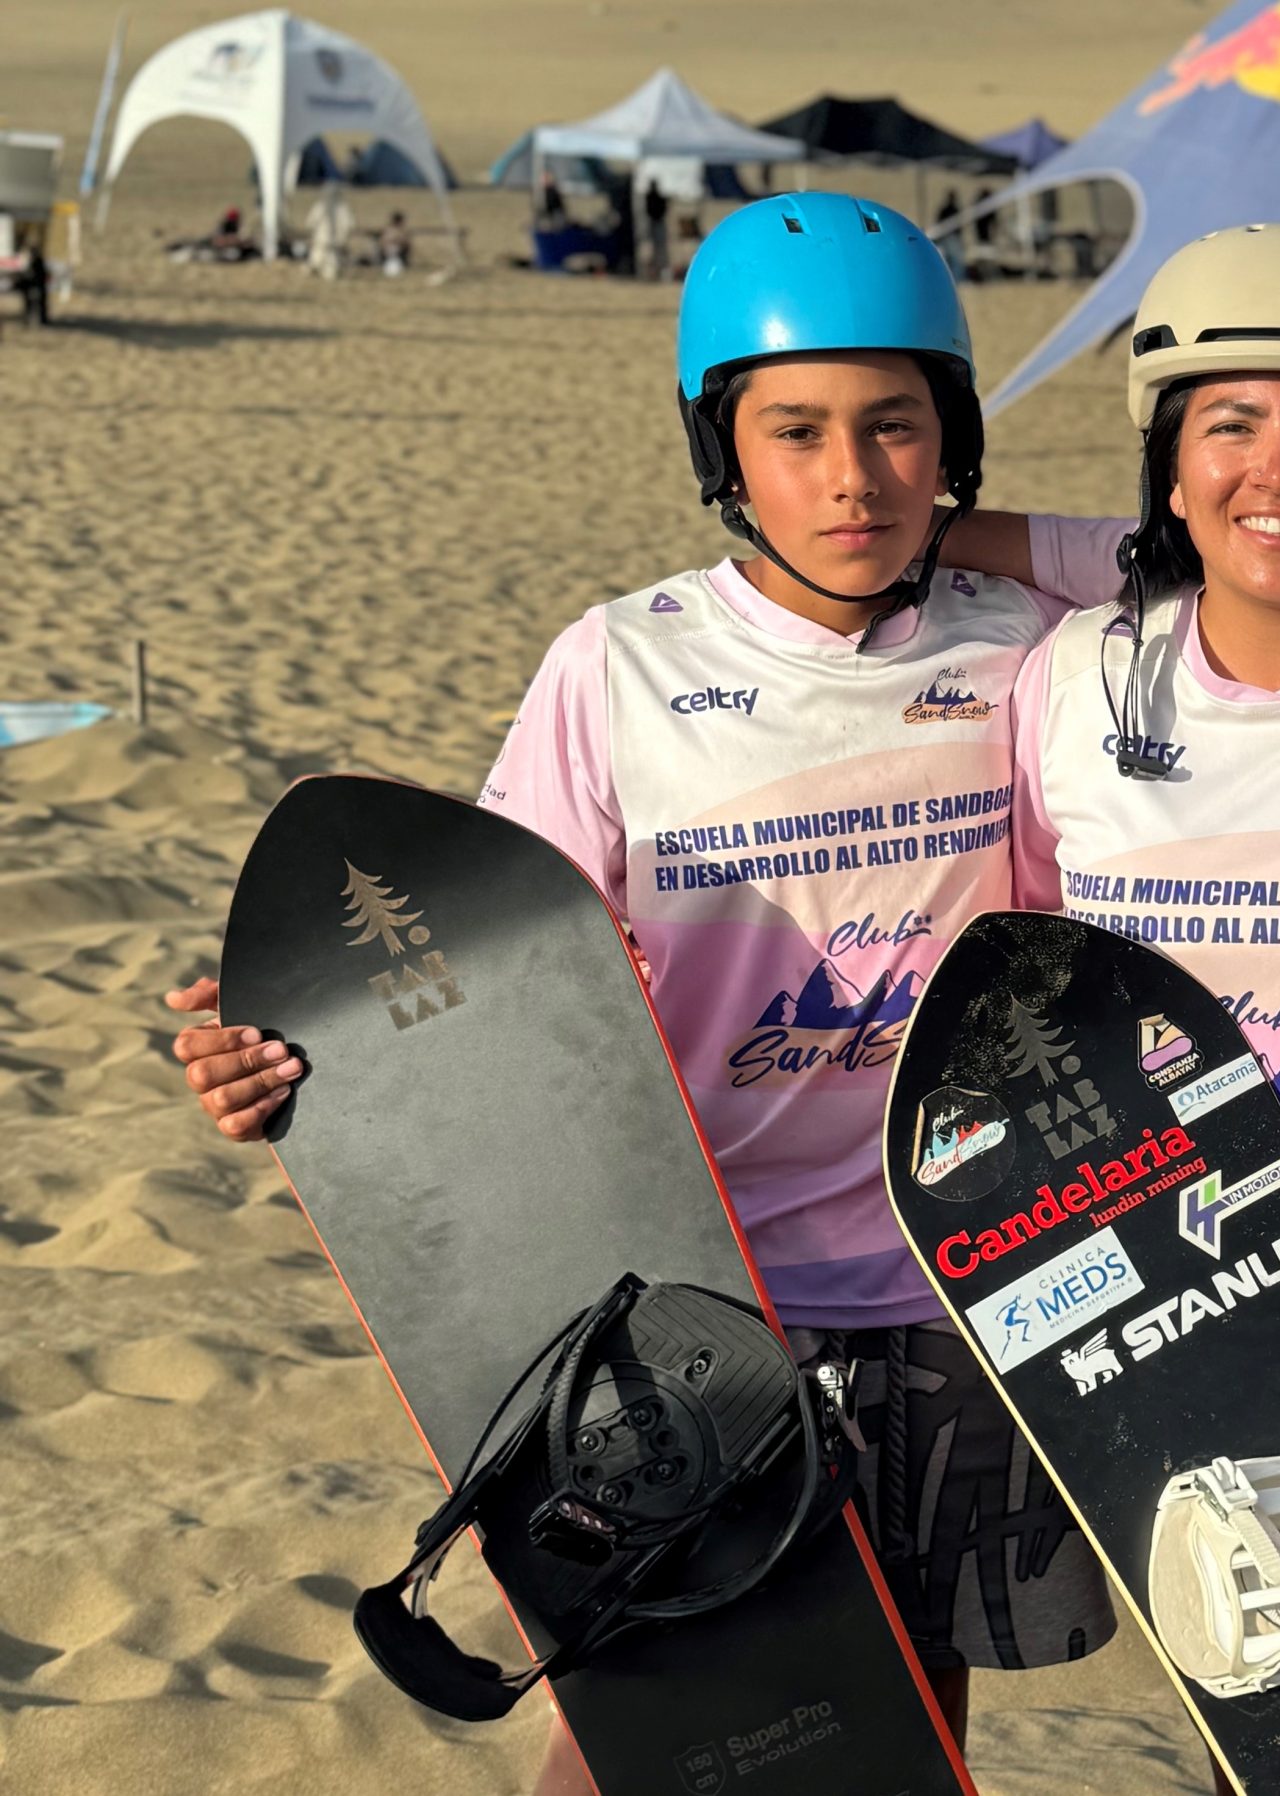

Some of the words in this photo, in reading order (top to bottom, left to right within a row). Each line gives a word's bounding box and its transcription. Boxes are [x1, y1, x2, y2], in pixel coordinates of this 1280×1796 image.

[670, 687, 760, 716] celtry
[655, 823, 749, 857] ESCUELA
[752, 805, 887, 846] MUNICIPAL
[892, 800, 920, 828] DE
[925, 783, 1014, 824] SANDBOA
[655, 866, 679, 892] EN
[683, 848, 831, 890] DESARROLLO
[836, 843, 863, 871] AL
[867, 836, 918, 867] ALTO
[1065, 871, 1126, 903] SCUELA
[826, 909, 932, 957] Club
[1211, 918, 1244, 944] AL
[728, 1021, 907, 1088] SandS
[1149, 1053, 1200, 1083] CONSTANZA
[1196, 1062, 1258, 1100] Atacama
[935, 1125, 1197, 1280] Candelaria
[1089, 1192, 1147, 1228] lundin
[1146, 1156, 1208, 1198] mining
[1228, 1189, 1243, 1204] IN
[1036, 1252, 1127, 1321] MEDS
[1039, 1247, 1106, 1289] CLINICA
[726, 1718, 791, 1758] Super
[791, 1700, 833, 1729] Pro
[735, 1721, 842, 1776] Evolution
